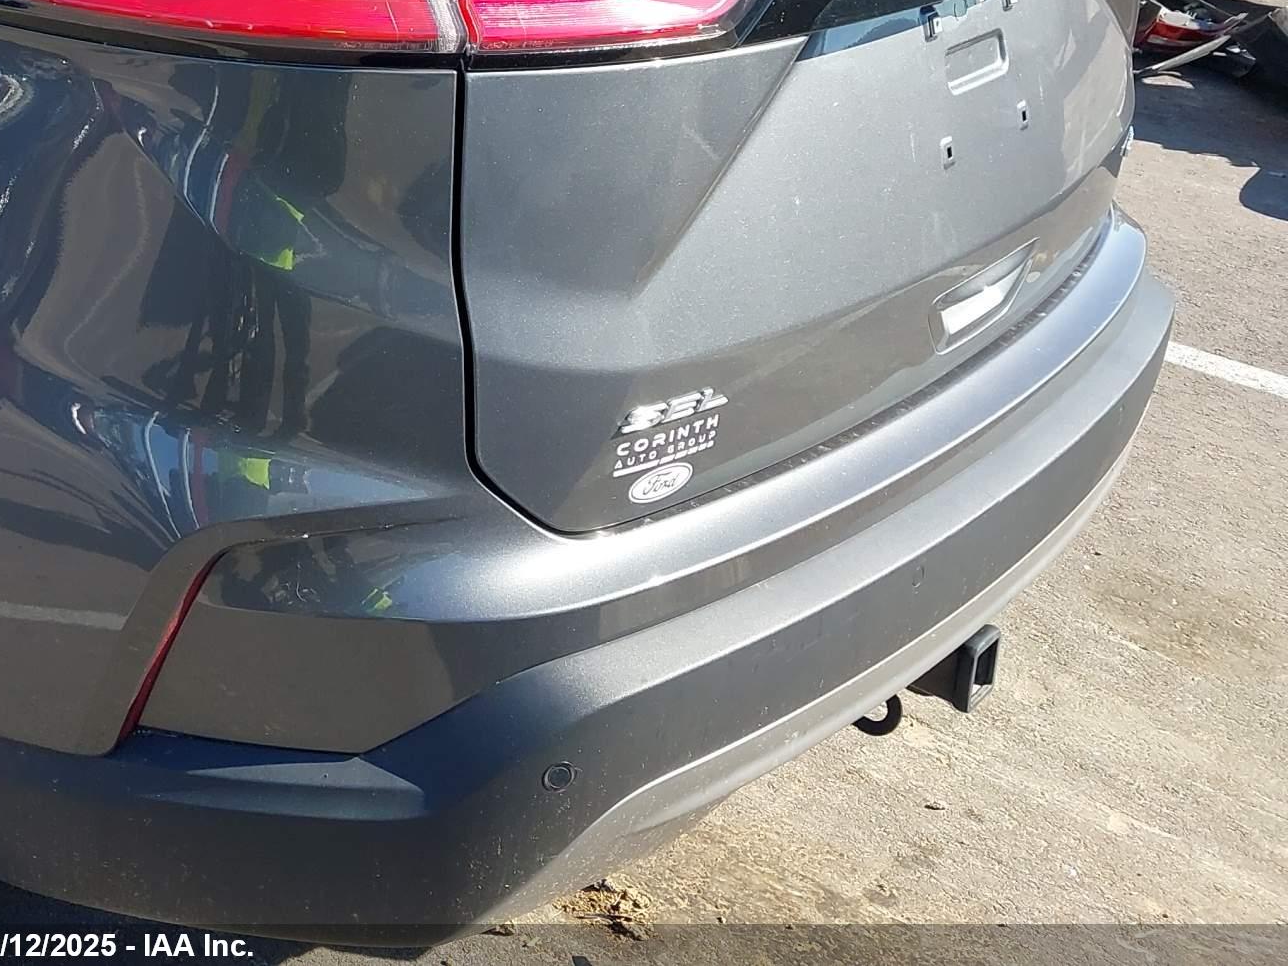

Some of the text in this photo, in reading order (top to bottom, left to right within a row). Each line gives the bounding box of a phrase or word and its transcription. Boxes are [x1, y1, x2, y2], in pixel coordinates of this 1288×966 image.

[620, 387, 730, 435] SEL
[614, 430, 717, 470] AUTO GROUP
[616, 413, 720, 456] CORINTH
[641, 470, 680, 496] Ford
